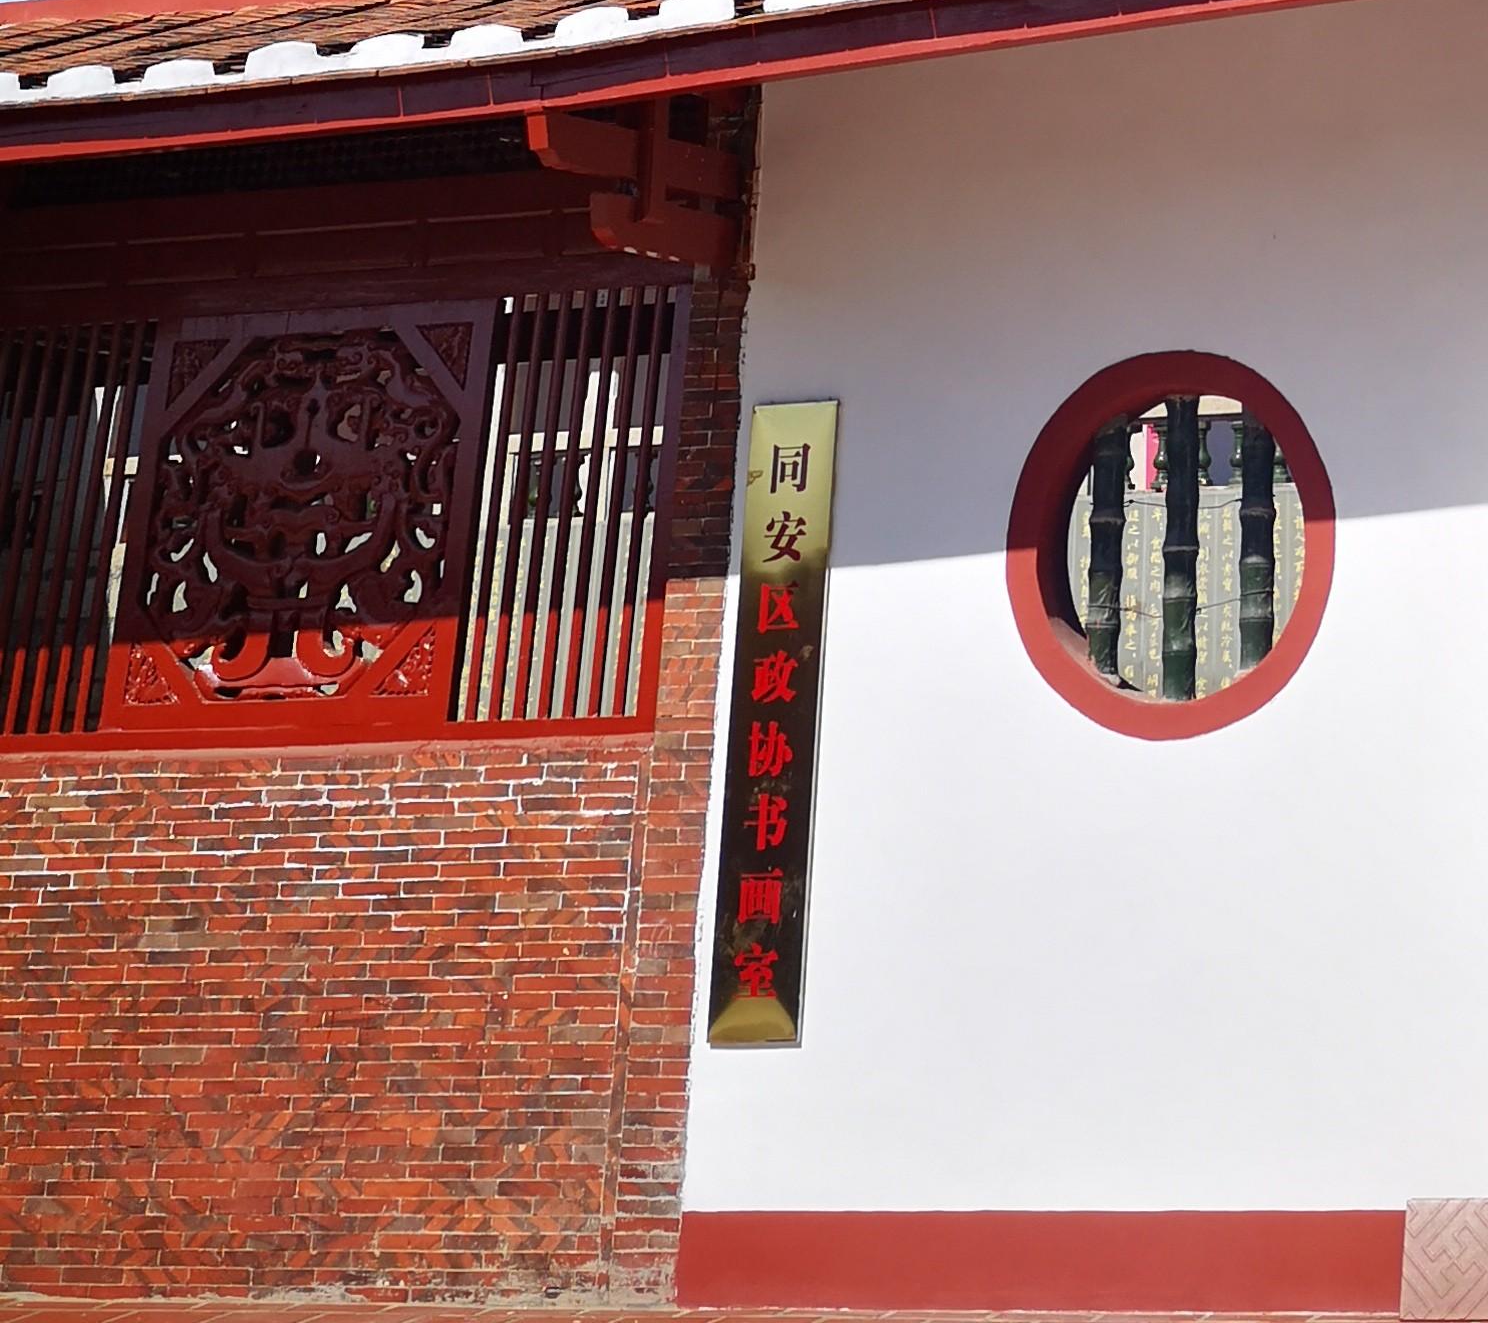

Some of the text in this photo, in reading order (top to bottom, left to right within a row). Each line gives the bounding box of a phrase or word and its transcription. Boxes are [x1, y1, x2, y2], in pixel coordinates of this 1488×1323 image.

[734, 442, 811, 1000] 同安区政协书画室
